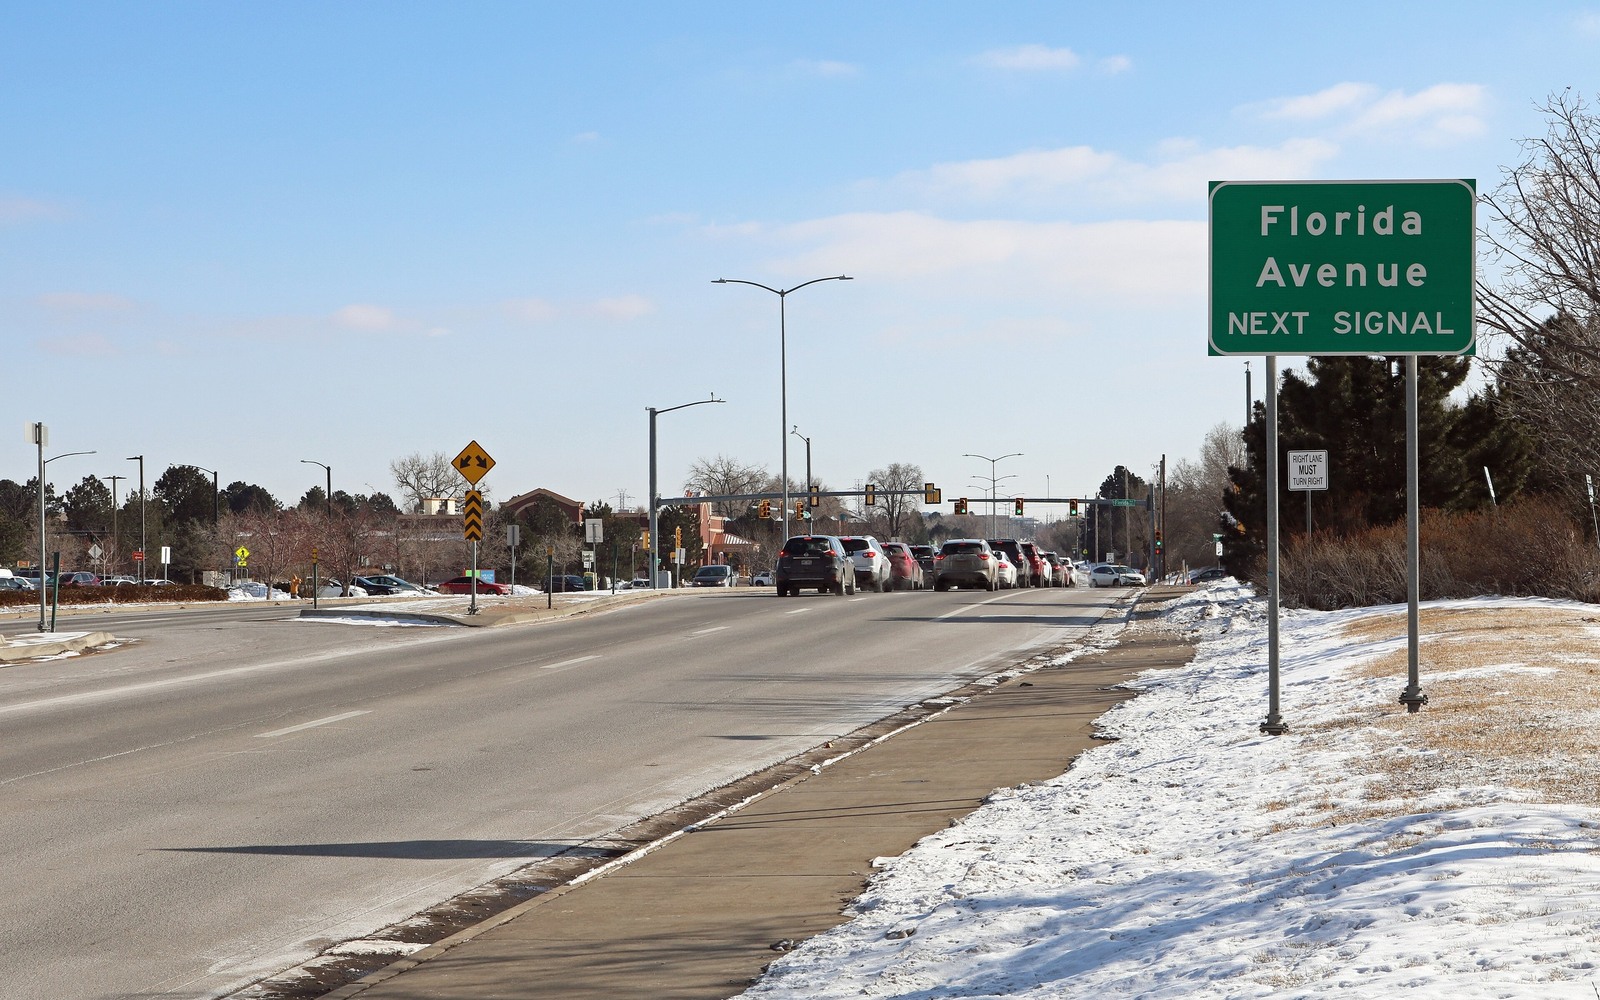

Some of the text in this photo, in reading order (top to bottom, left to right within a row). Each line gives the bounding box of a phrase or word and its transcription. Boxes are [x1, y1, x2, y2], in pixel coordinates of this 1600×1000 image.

[1261, 204, 1422, 236] Florida
[1256, 256, 1427, 288] Avenue
[1228, 311, 1455, 335] NEXT SIGNAL
[1292, 454, 1323, 463] RIGHT LANE
[1298, 464, 1316, 475] MUST
[1293, 477, 1323, 486] TURN RIGHT
